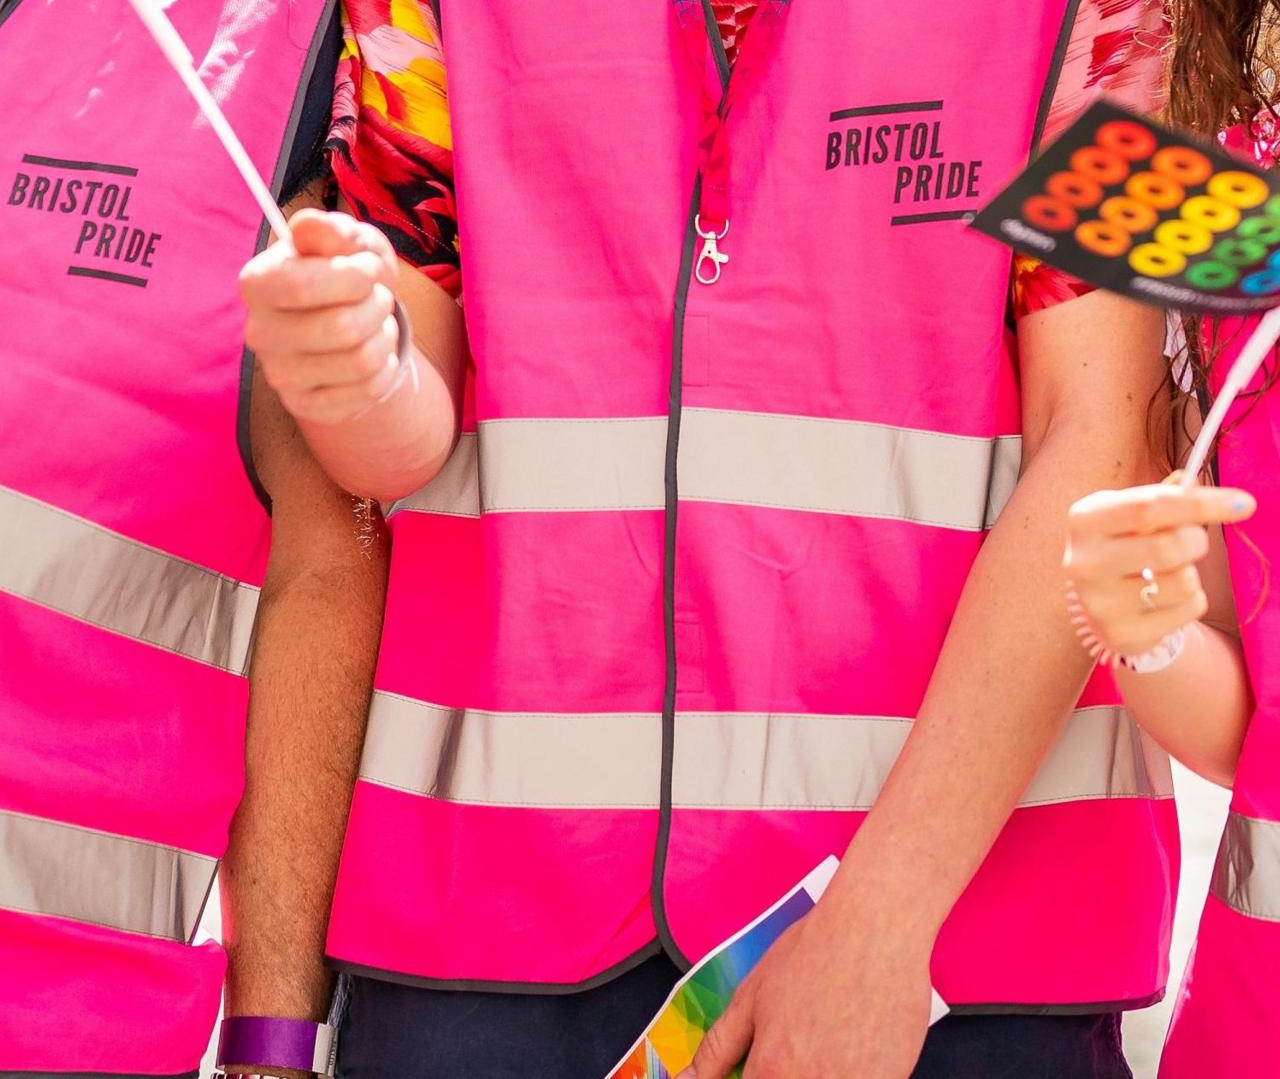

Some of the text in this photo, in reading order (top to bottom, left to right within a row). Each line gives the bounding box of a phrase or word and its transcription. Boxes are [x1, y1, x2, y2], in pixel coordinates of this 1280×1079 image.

[826, 122, 944, 170] BRISTOL
[7, 173, 132, 221] BRISTOL
[893, 161, 983, 204] PRIDE
[74, 220, 162, 267] PRIDE
